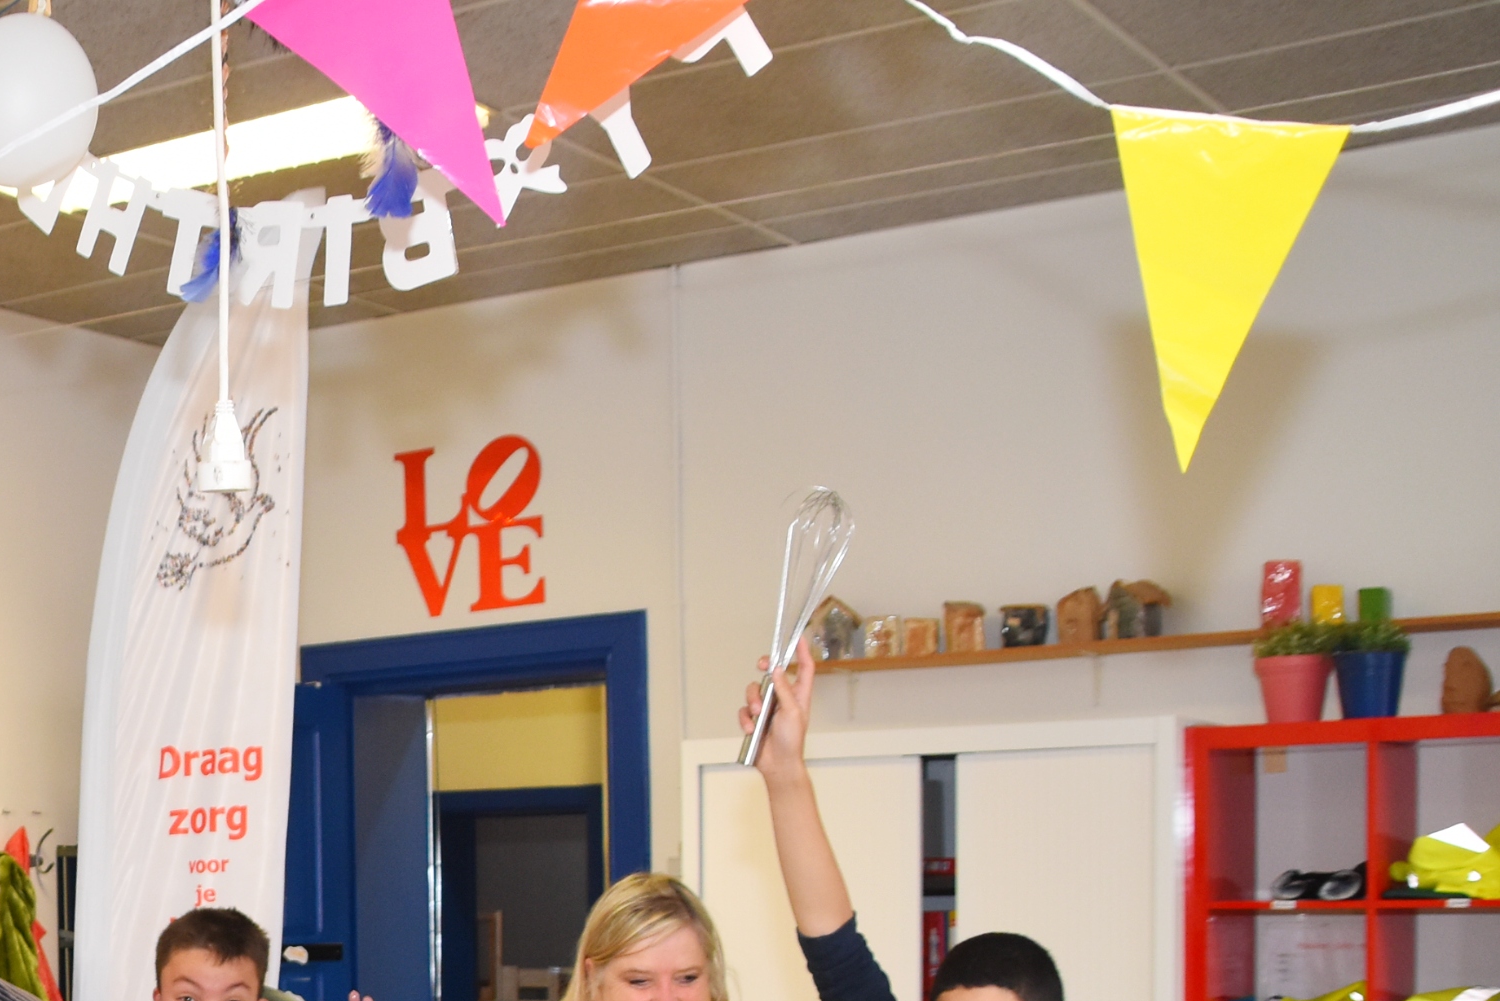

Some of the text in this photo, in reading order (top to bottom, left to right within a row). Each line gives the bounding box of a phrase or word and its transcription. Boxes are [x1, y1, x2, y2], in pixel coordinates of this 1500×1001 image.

[158, 745, 263, 781] Draag
[168, 804, 248, 840] zorg
[189, 858, 230, 874] voor
[194, 884, 217, 907] je
